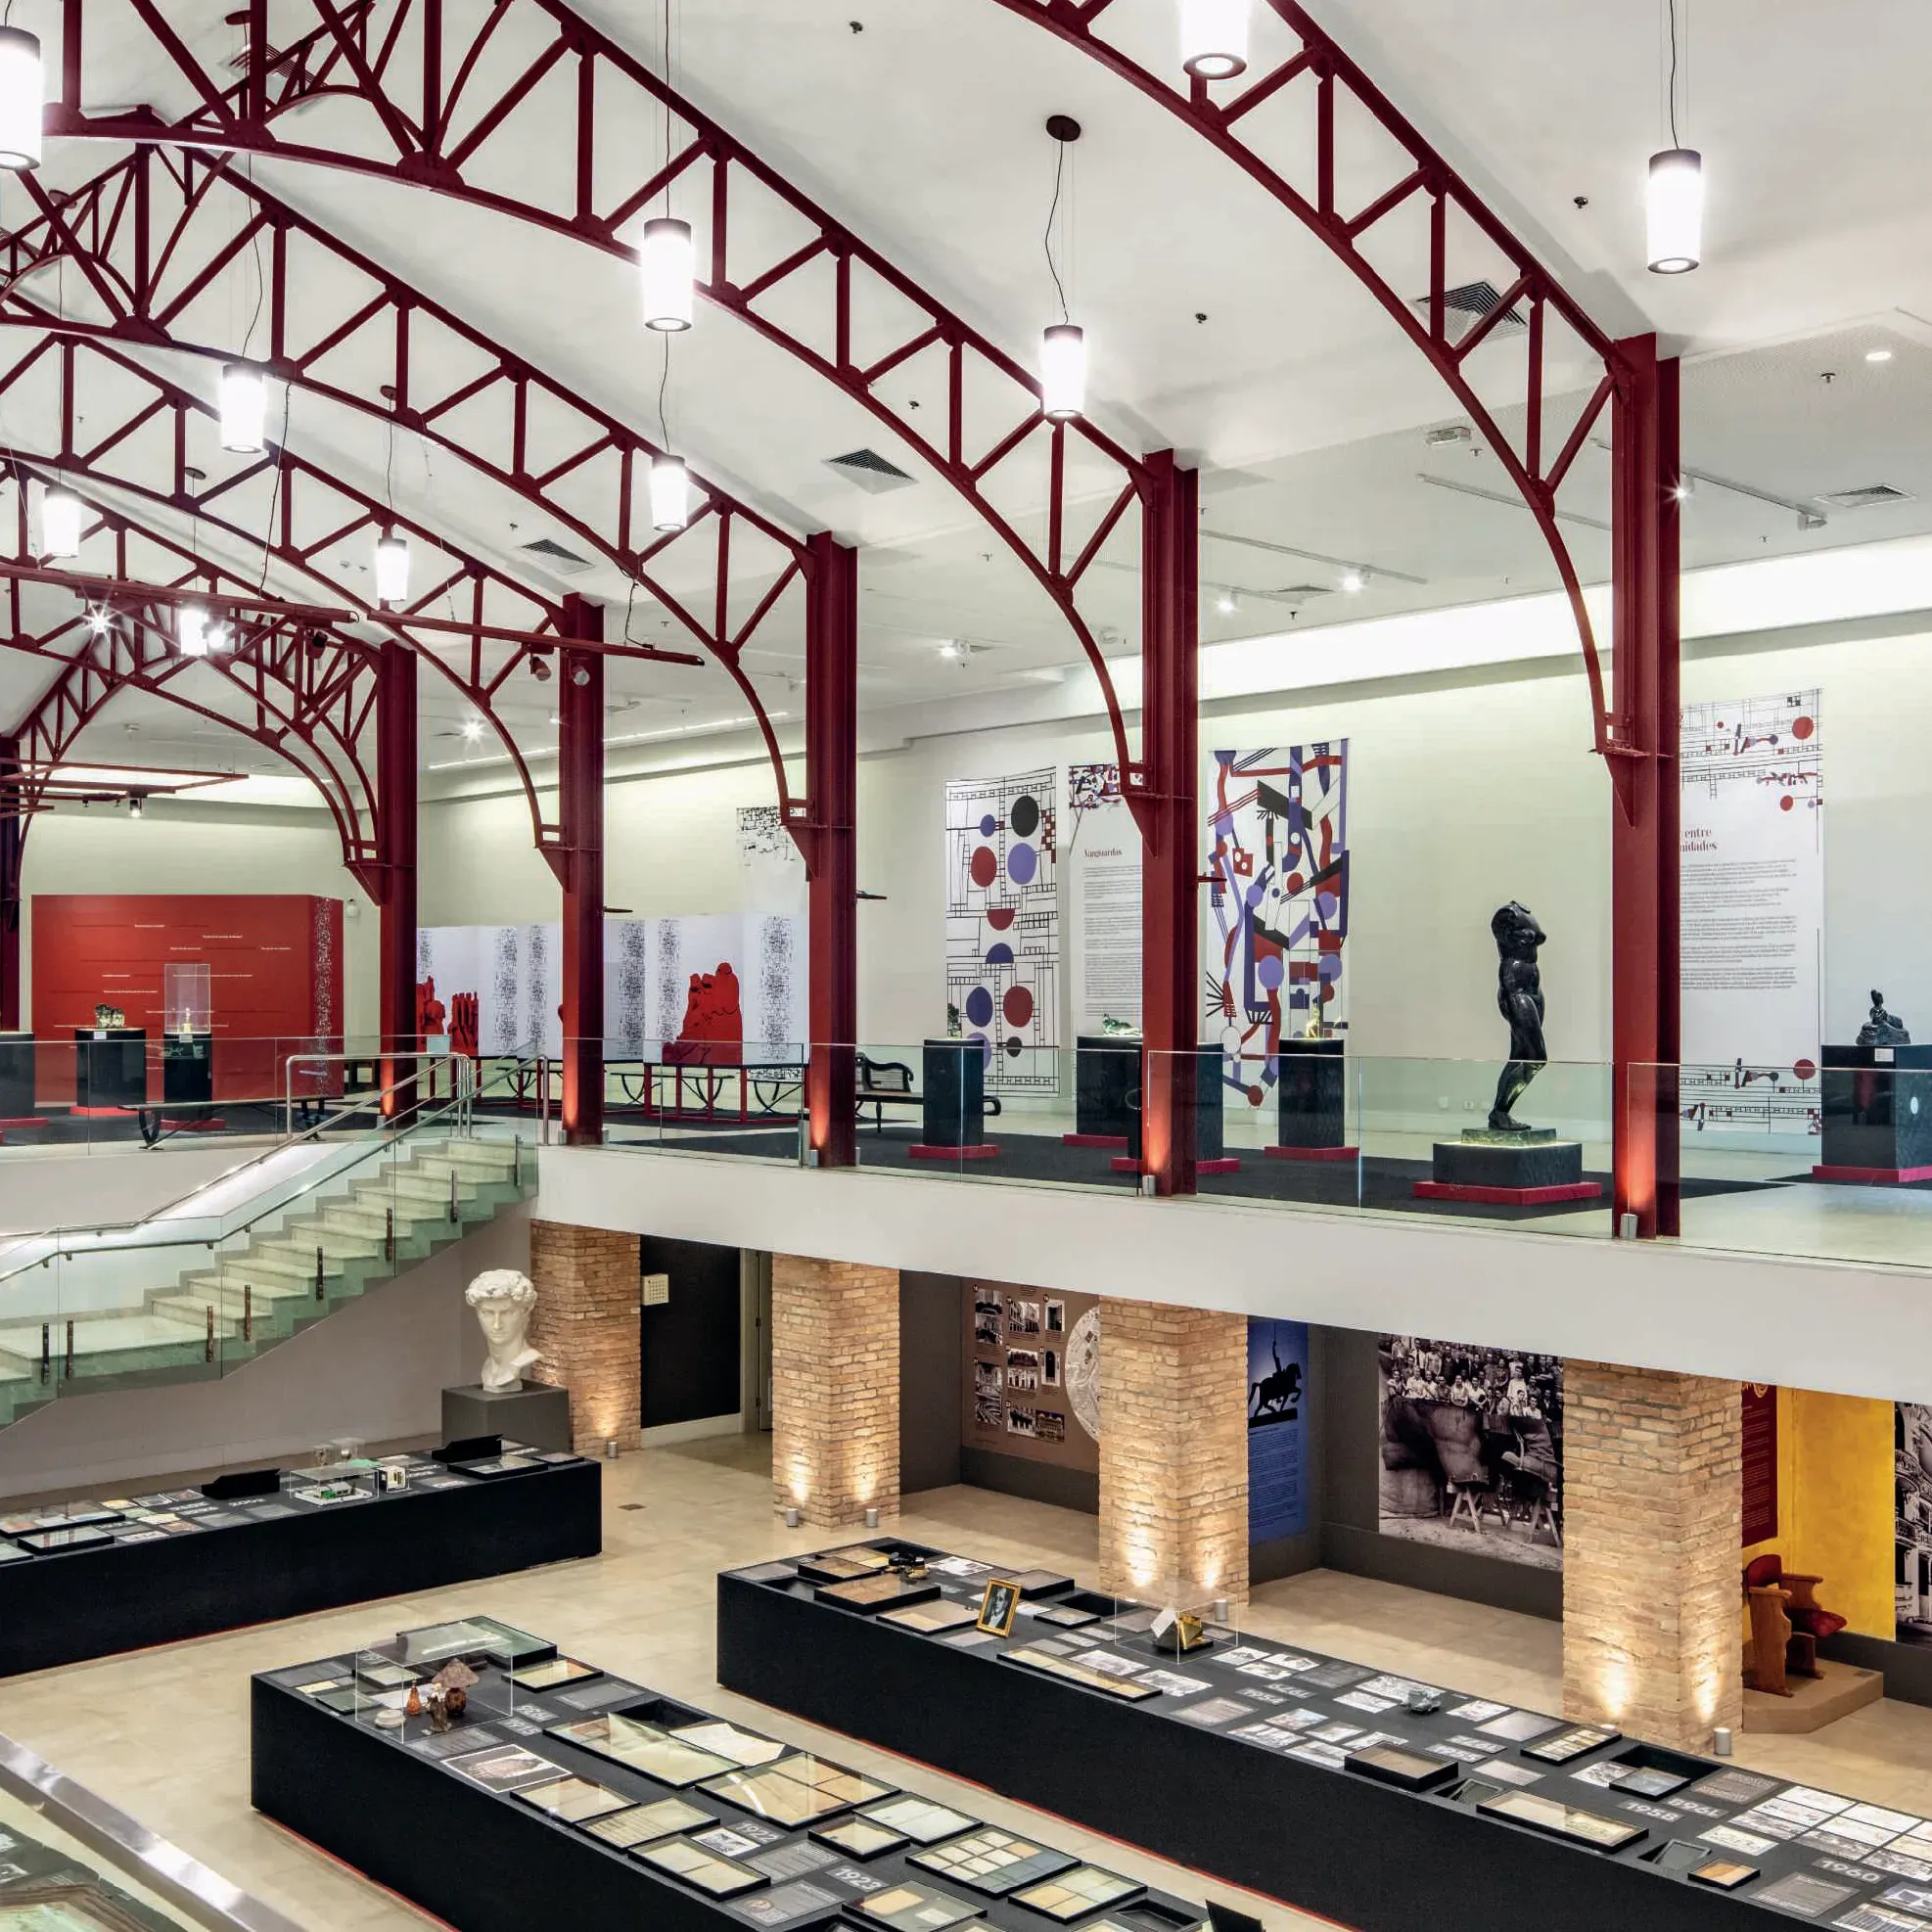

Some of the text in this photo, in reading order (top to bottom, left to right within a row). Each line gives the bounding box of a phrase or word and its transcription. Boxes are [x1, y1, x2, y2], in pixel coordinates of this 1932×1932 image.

[1084, 848, 1123, 858] Vanguardas
[1626, 1801, 1679, 1821] 1958
[1667, 1798, 1721, 1817] 1968
[735, 1821, 780, 1844] 1922
[834, 1867, 882, 1892] 1923
[1820, 1859, 1881, 1882] 1960
